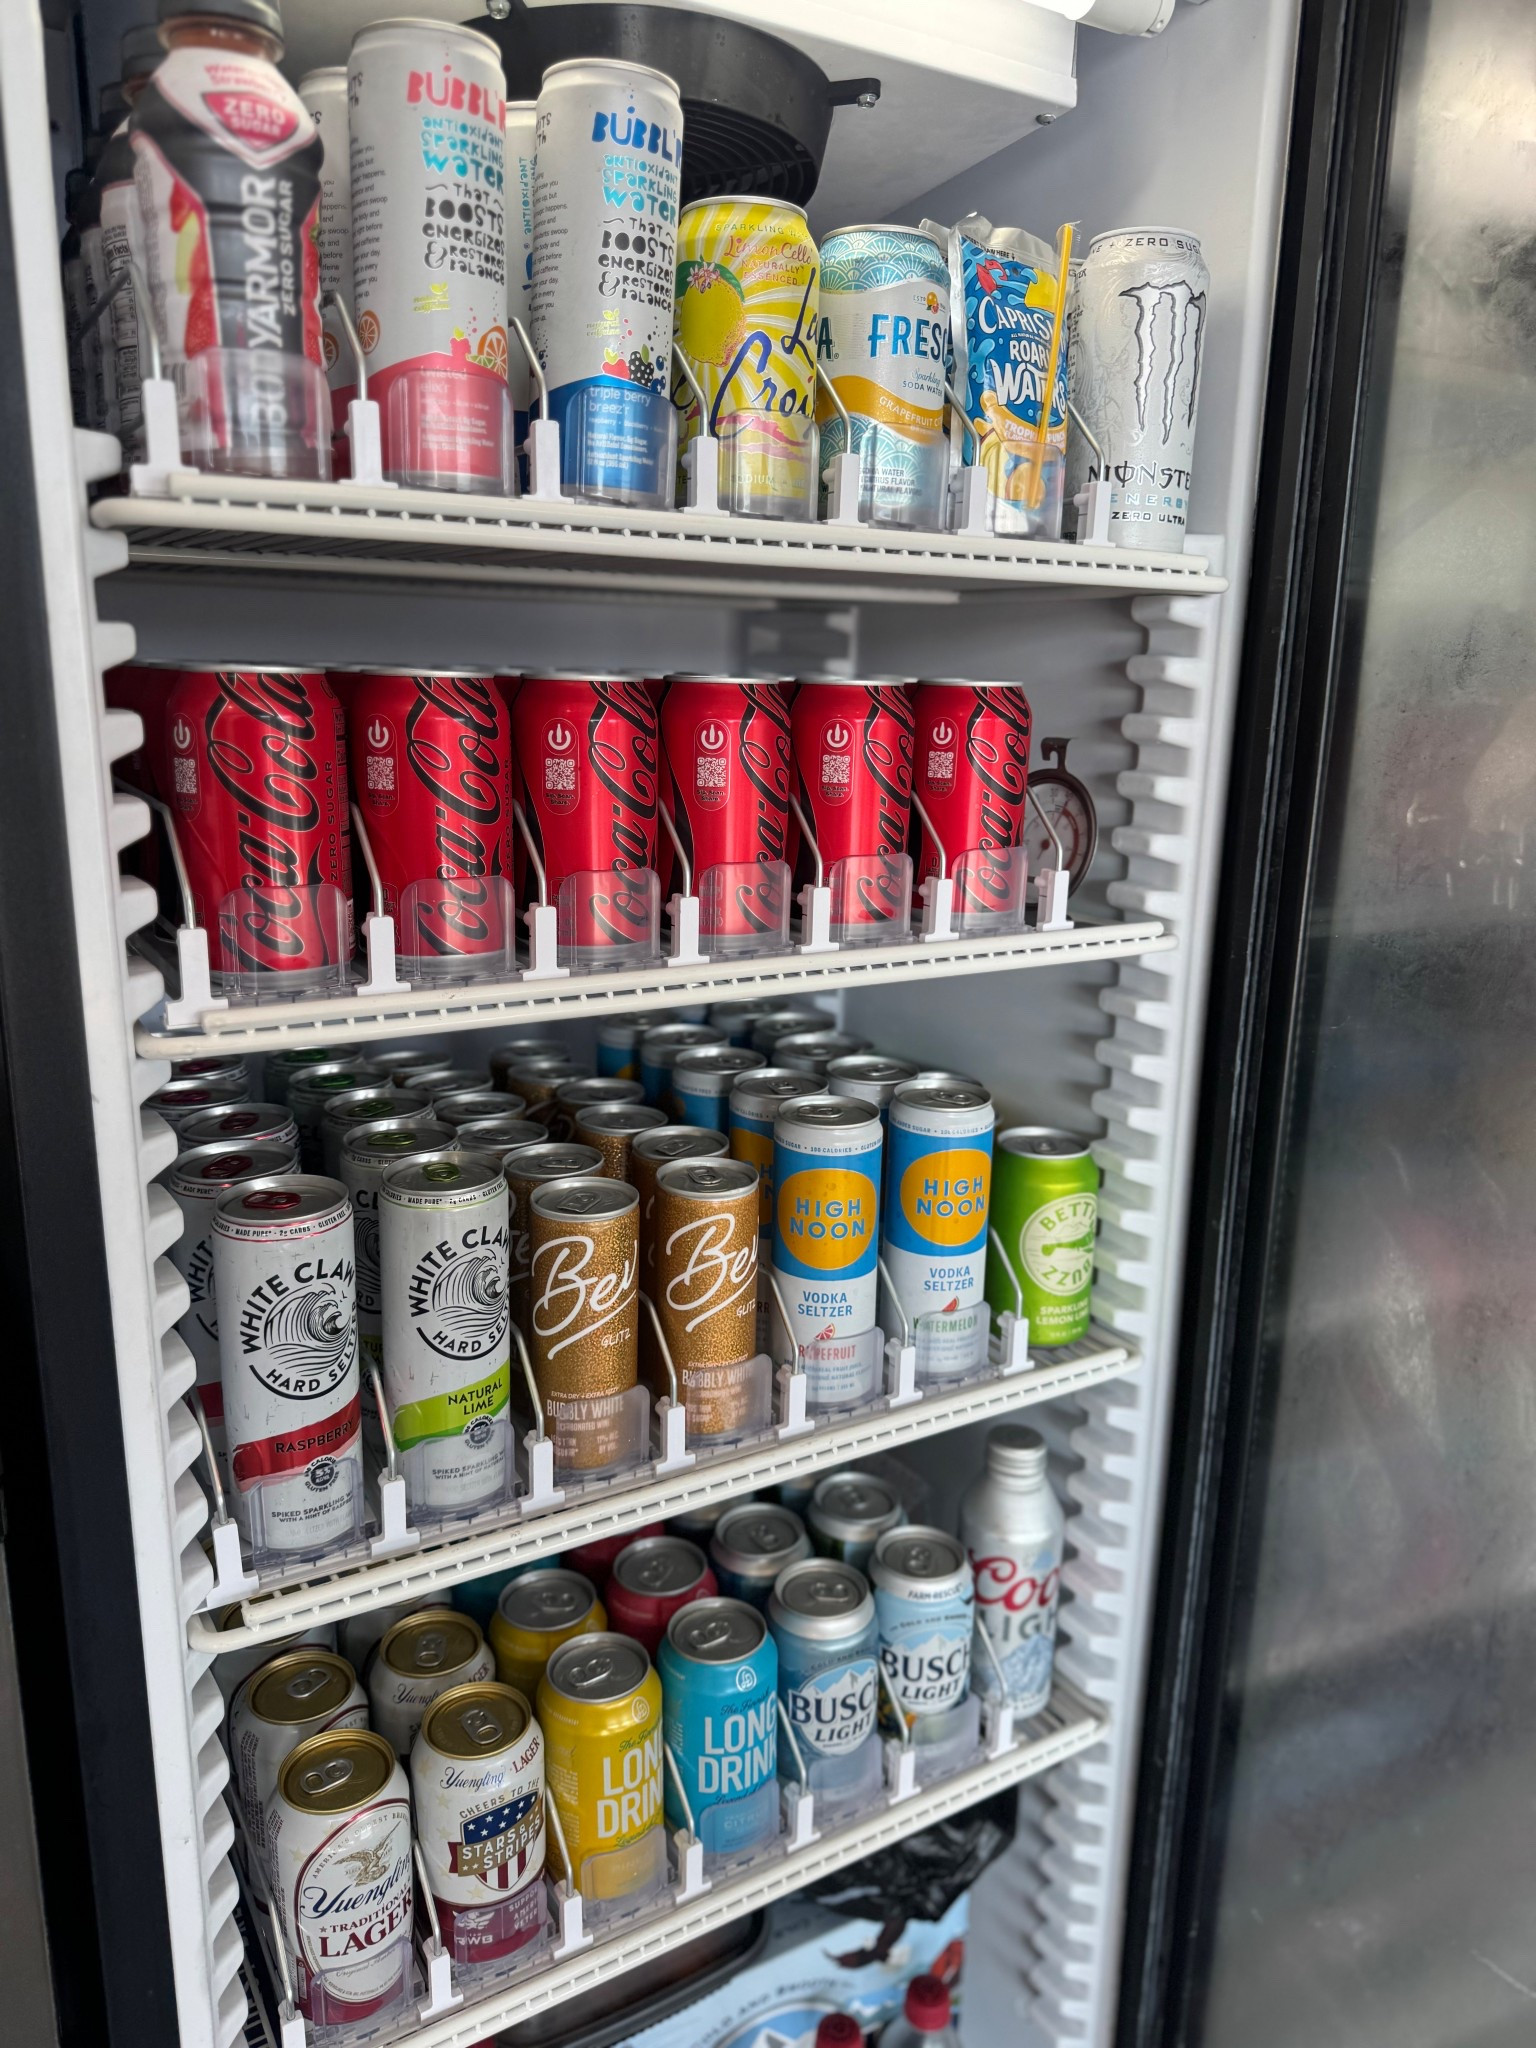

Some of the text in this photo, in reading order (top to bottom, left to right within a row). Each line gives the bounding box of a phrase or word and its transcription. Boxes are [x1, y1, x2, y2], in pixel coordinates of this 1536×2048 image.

[224, 97, 286, 126] ZERO
[716, 223, 784, 235] SPARKLING
[279, 180, 295, 316] ZERO SUGAR
[1125, 237, 1169, 247] ZERO
[996, 250, 1010, 258] HERE
[741, 260, 801, 274] NATURALLY
[743, 272, 798, 286] ESSENCED
[868, 313, 949, 367] FRES
[590, 386, 620, 400] triple
[709, 330, 815, 441] Croi
[902, 381, 925, 391] SODA
[990, 359, 1066, 420] WATRS
[879, 396, 933, 427] GRAPEFRUIT
[882, 467, 904, 477] WATER
[1088, 460, 1190, 490] MONSTE
[1112, 511, 1185, 526] ZERO ULTRA
[324, 760, 338, 882] ZERO SUGAR
[912, 1124, 931, 1133] SUGAR
[785, 1140, 801, 1149] SUGAR
[924, 1176, 983, 1197] HIGH
[408, 1196, 422, 1204] MADE
[796, 1198, 861, 1218] HIGH
[916, 1195, 985, 1217] NOON
[235, 1227, 250, 1236] MADE
[290, 1225, 311, 1235] CARBS
[790, 1216, 865, 1240] NOON
[188, 1240, 213, 1302] WHIT
[408, 1240, 458, 1317] WHITE
[929, 1265, 970, 1279] VODKA
[924, 1277, 974, 1292] SELTZER
[240, 1258, 355, 1354] WHITE CLAW
[803, 1290, 848, 1304] VODKA
[798, 1303, 853, 1318] SELTZER
[1036, 1314, 1073, 1325] LEMON
[432, 1330, 482, 1354] HARD
[601, 1328, 631, 1348] GLITZ
[798, 1344, 857, 1361] RAPEFRUIT
[266, 1369, 321, 1392] HARD
[448, 1377, 503, 1406] NATURAL
[463, 1395, 494, 1415] LIME
[591, 1395, 624, 1420] WHITE
[275, 1416, 354, 1454] RASPBERRY
[432, 1467, 460, 1475] SPIKED
[305, 1481, 329, 1492] GLUTEN
[304, 1496, 345, 1515] SPARKLING
[969, 1549, 1060, 1611] Coo
[979, 1609, 1055, 1642] LIG
[393, 1683, 438, 1706] Yuengl
[901, 1677, 961, 1700] LIGHT
[789, 1681, 875, 1724] BUSC
[705, 1691, 776, 1755] LONG
[814, 1712, 872, 1742] LIGHT
[440, 1739, 540, 1792] Yuengling LAGER
[459, 1777, 539, 1818] CHEERS TO THE
[597, 1766, 663, 1839] DRIN
[462, 1823, 525, 1860] STARS &
[483, 1817, 540, 1869] STRIPES
[301, 1853, 411, 1919] Yuengling
[329, 1882, 408, 1933] TRADITIONAL
[319, 1888, 412, 1958] LAGER
